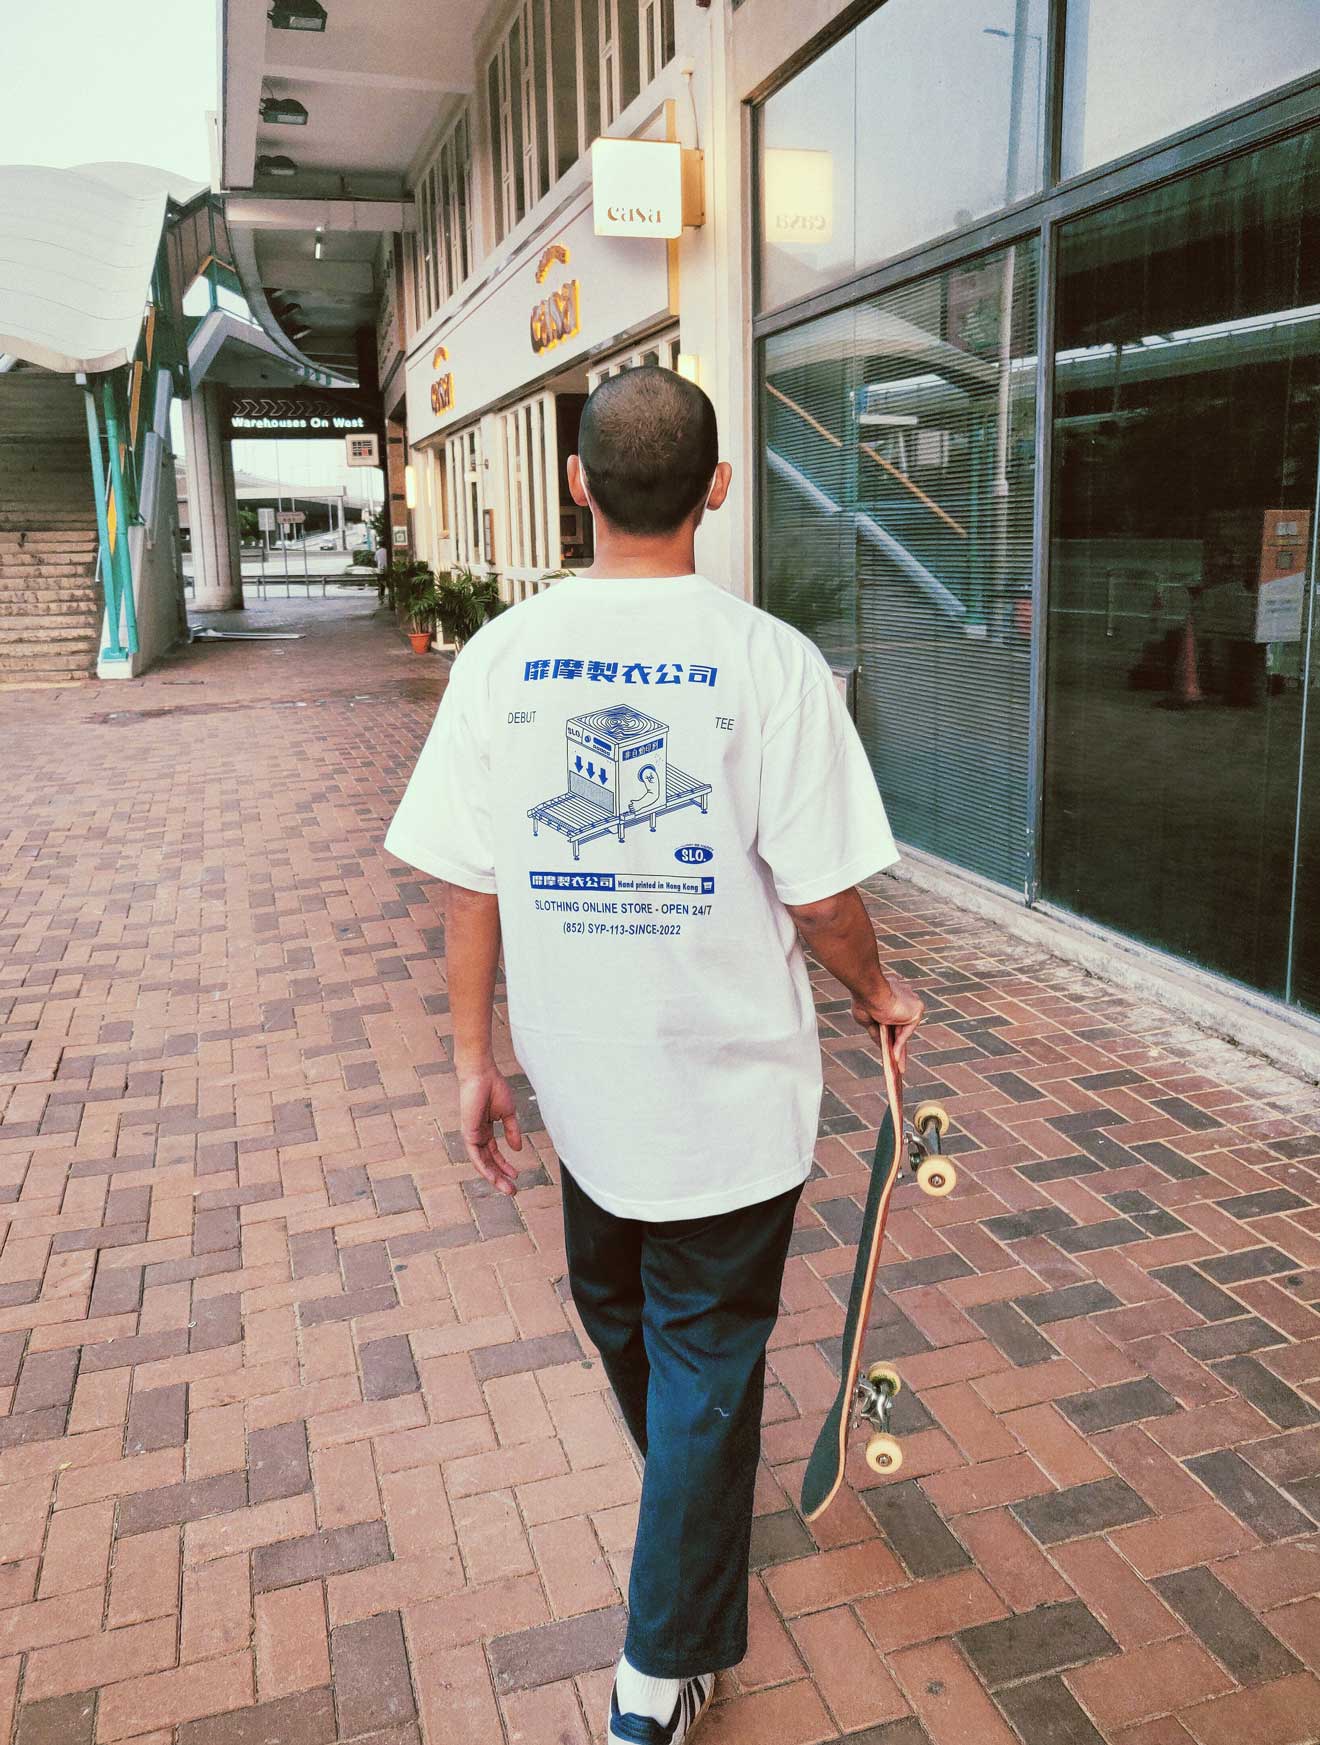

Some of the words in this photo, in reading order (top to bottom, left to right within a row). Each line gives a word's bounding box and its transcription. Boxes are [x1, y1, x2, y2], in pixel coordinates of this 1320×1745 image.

[231, 417, 307, 429] Warehouses
[310, 417, 329, 428] On
[332, 417, 364, 428] West
[507, 711, 536, 724] DEBUT
[715, 716, 735, 731] TEE
[617, 880, 634, 889] Hand
[635, 881, 656, 891] printed
[666, 882, 681, 892] Hong
[682, 883, 699, 893] Kong
[535, 900, 580, 912] SLOTHING
[582, 902, 618, 914] ONLINE
[620, 903, 653, 915] STORE
[661, 904, 689, 915] OPEN
[691, 905, 712, 916] 24/7
[563, 922, 585, 935] (852)
[587, 923, 681, 936] SYP-113-SINCE-2022
